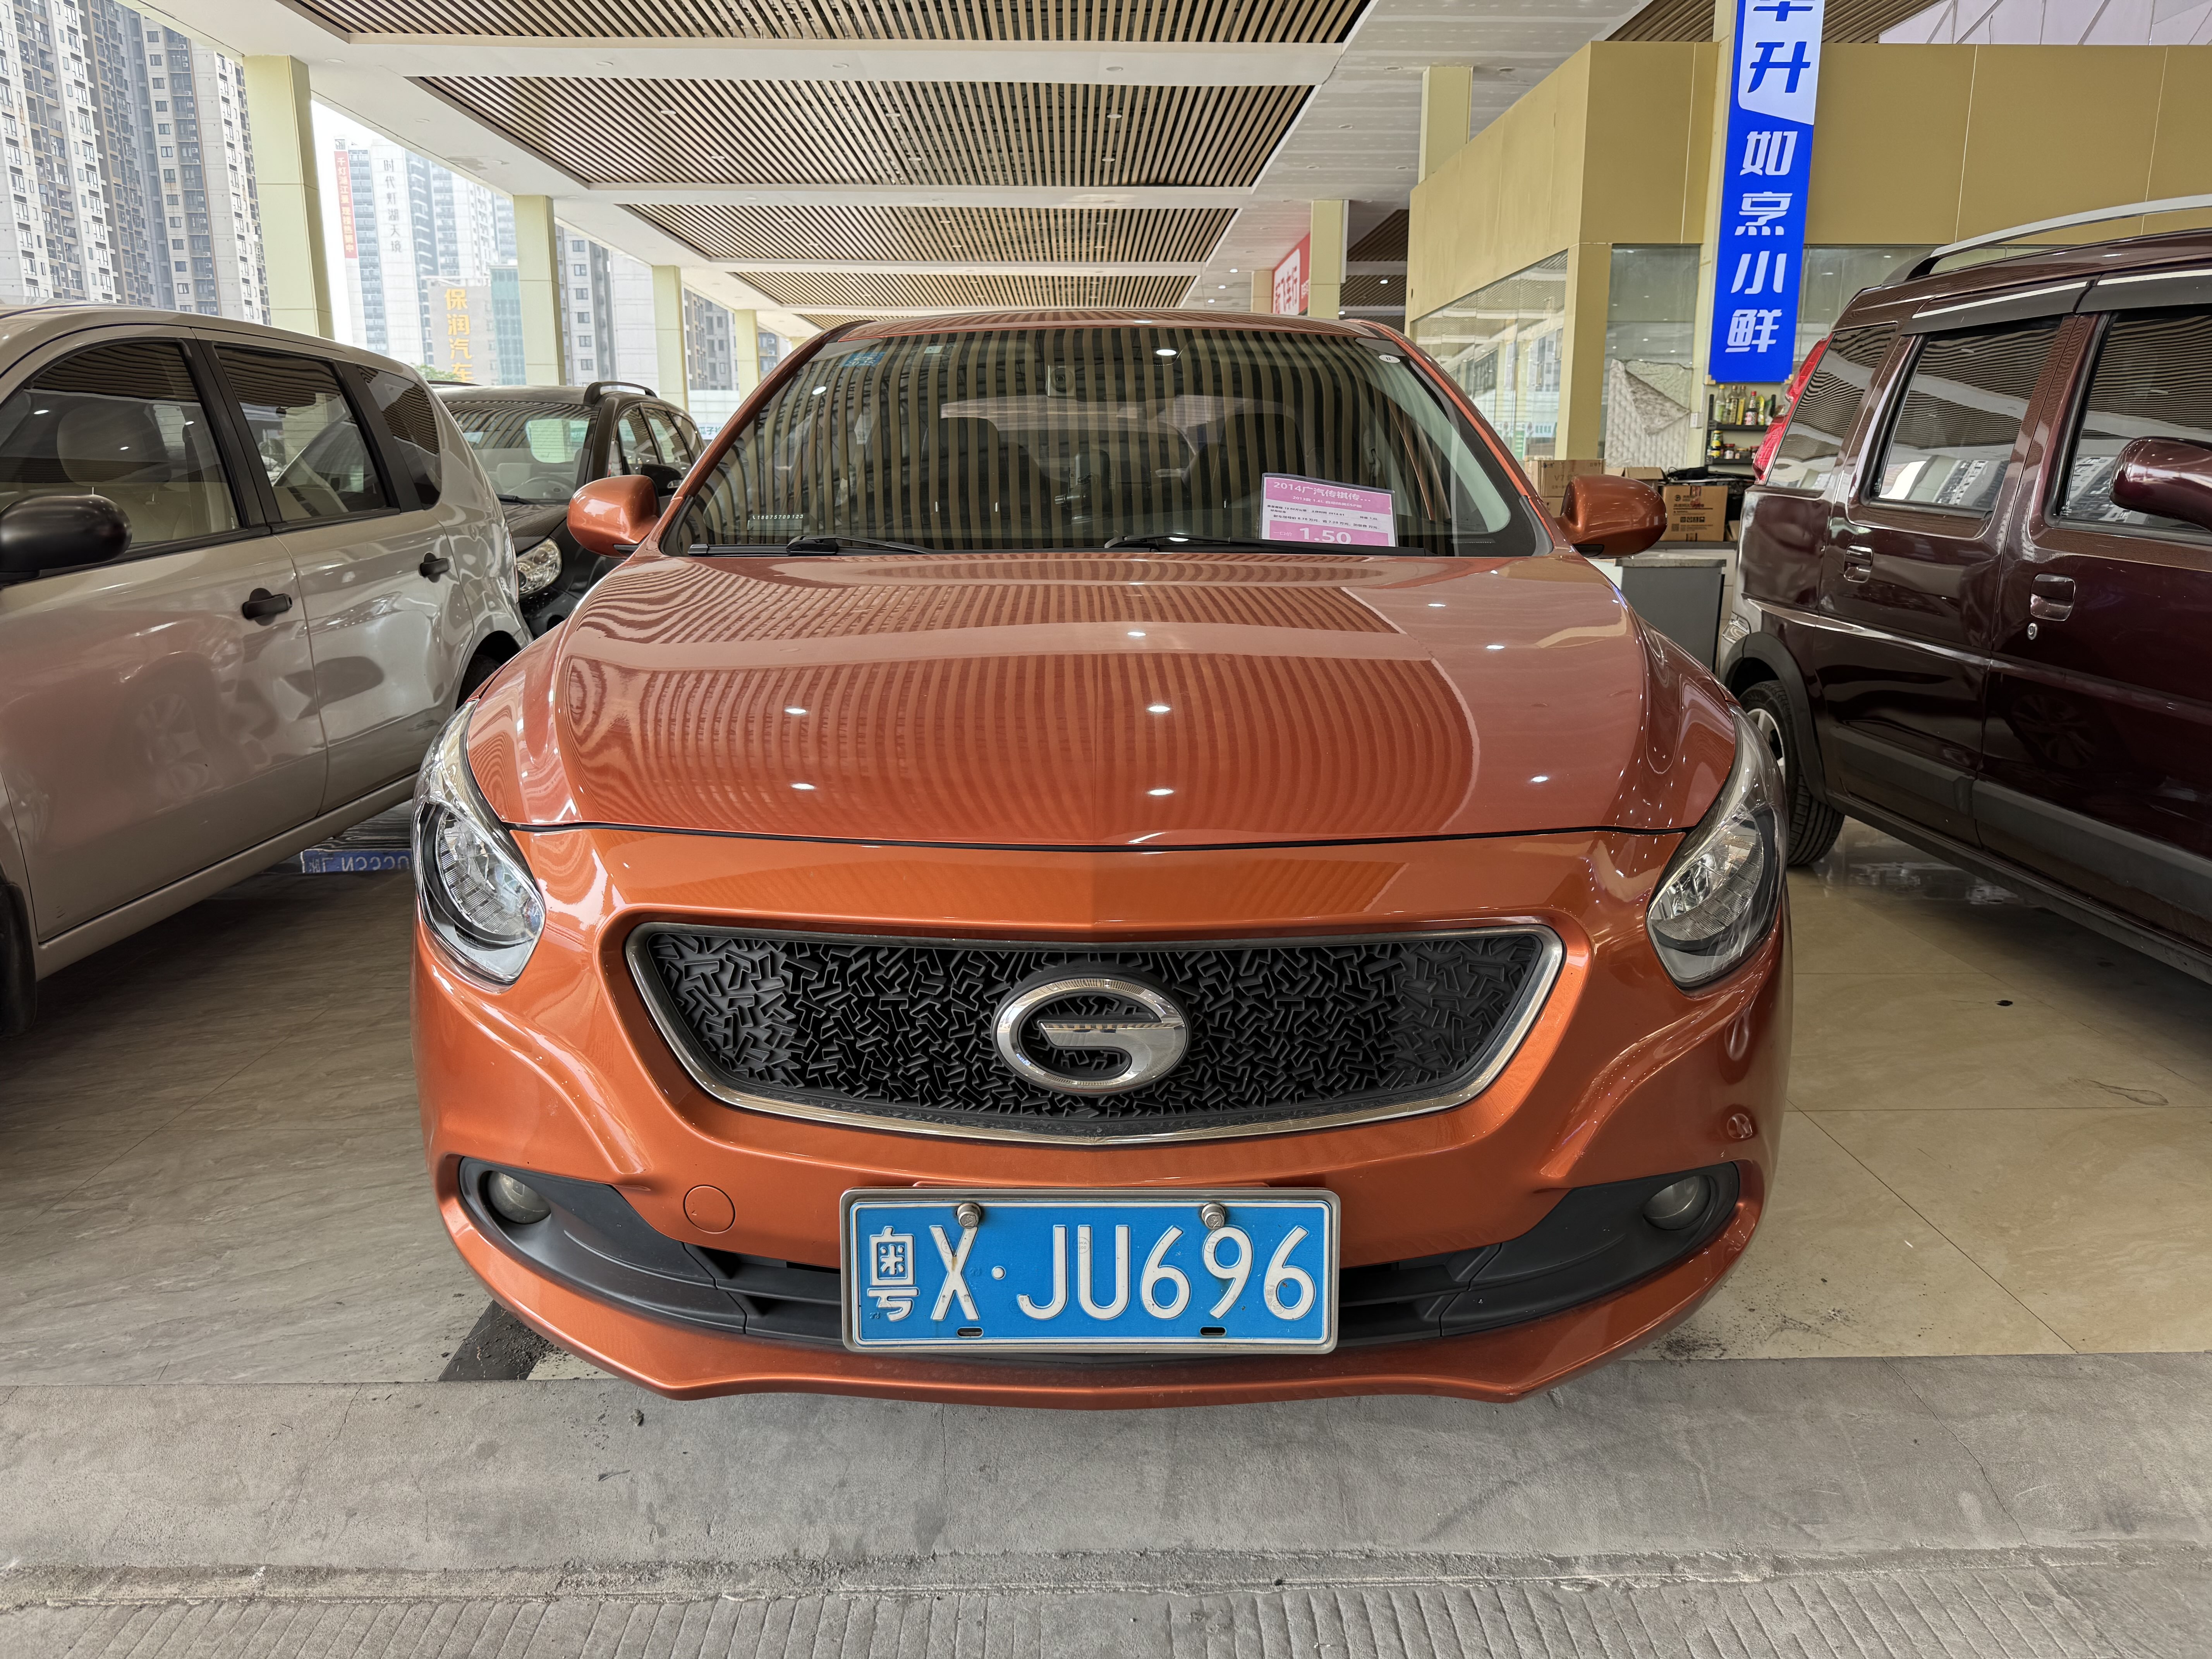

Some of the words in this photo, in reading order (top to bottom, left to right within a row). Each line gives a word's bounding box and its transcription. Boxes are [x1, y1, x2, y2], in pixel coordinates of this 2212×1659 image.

[384, 159, 402, 252] 时代灯湖天境
[1725, 131, 1798, 353] 如烹小鲜
[445, 288, 474, 382] 保润汽车
[1300, 527, 1352, 544] 1.50
[867, 1225, 1316, 1321] 粤X·JU696
